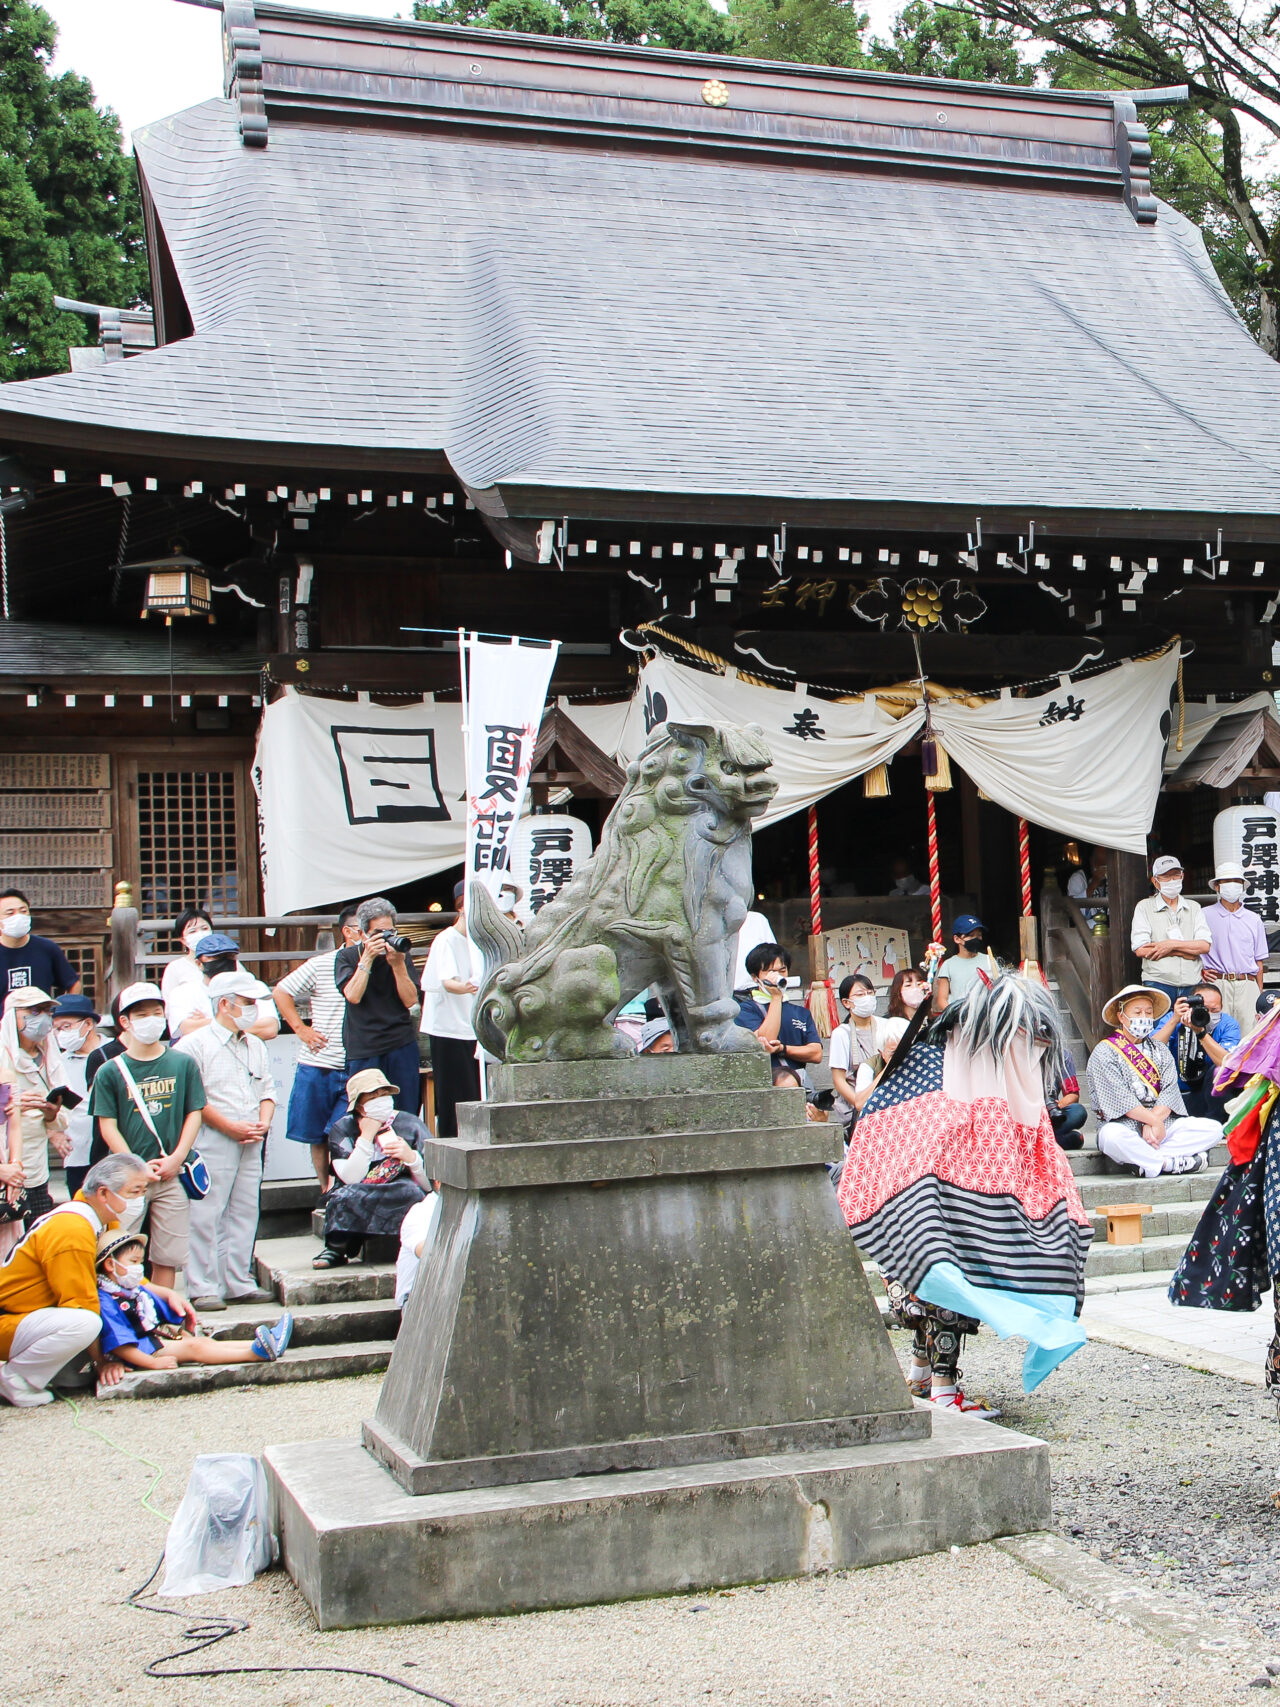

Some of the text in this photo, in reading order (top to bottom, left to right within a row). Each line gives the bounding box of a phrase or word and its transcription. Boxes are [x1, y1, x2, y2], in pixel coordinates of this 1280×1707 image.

[474, 724, 528, 872] 夏詣
[1241, 816, 1280, 922] 戸澤神社
